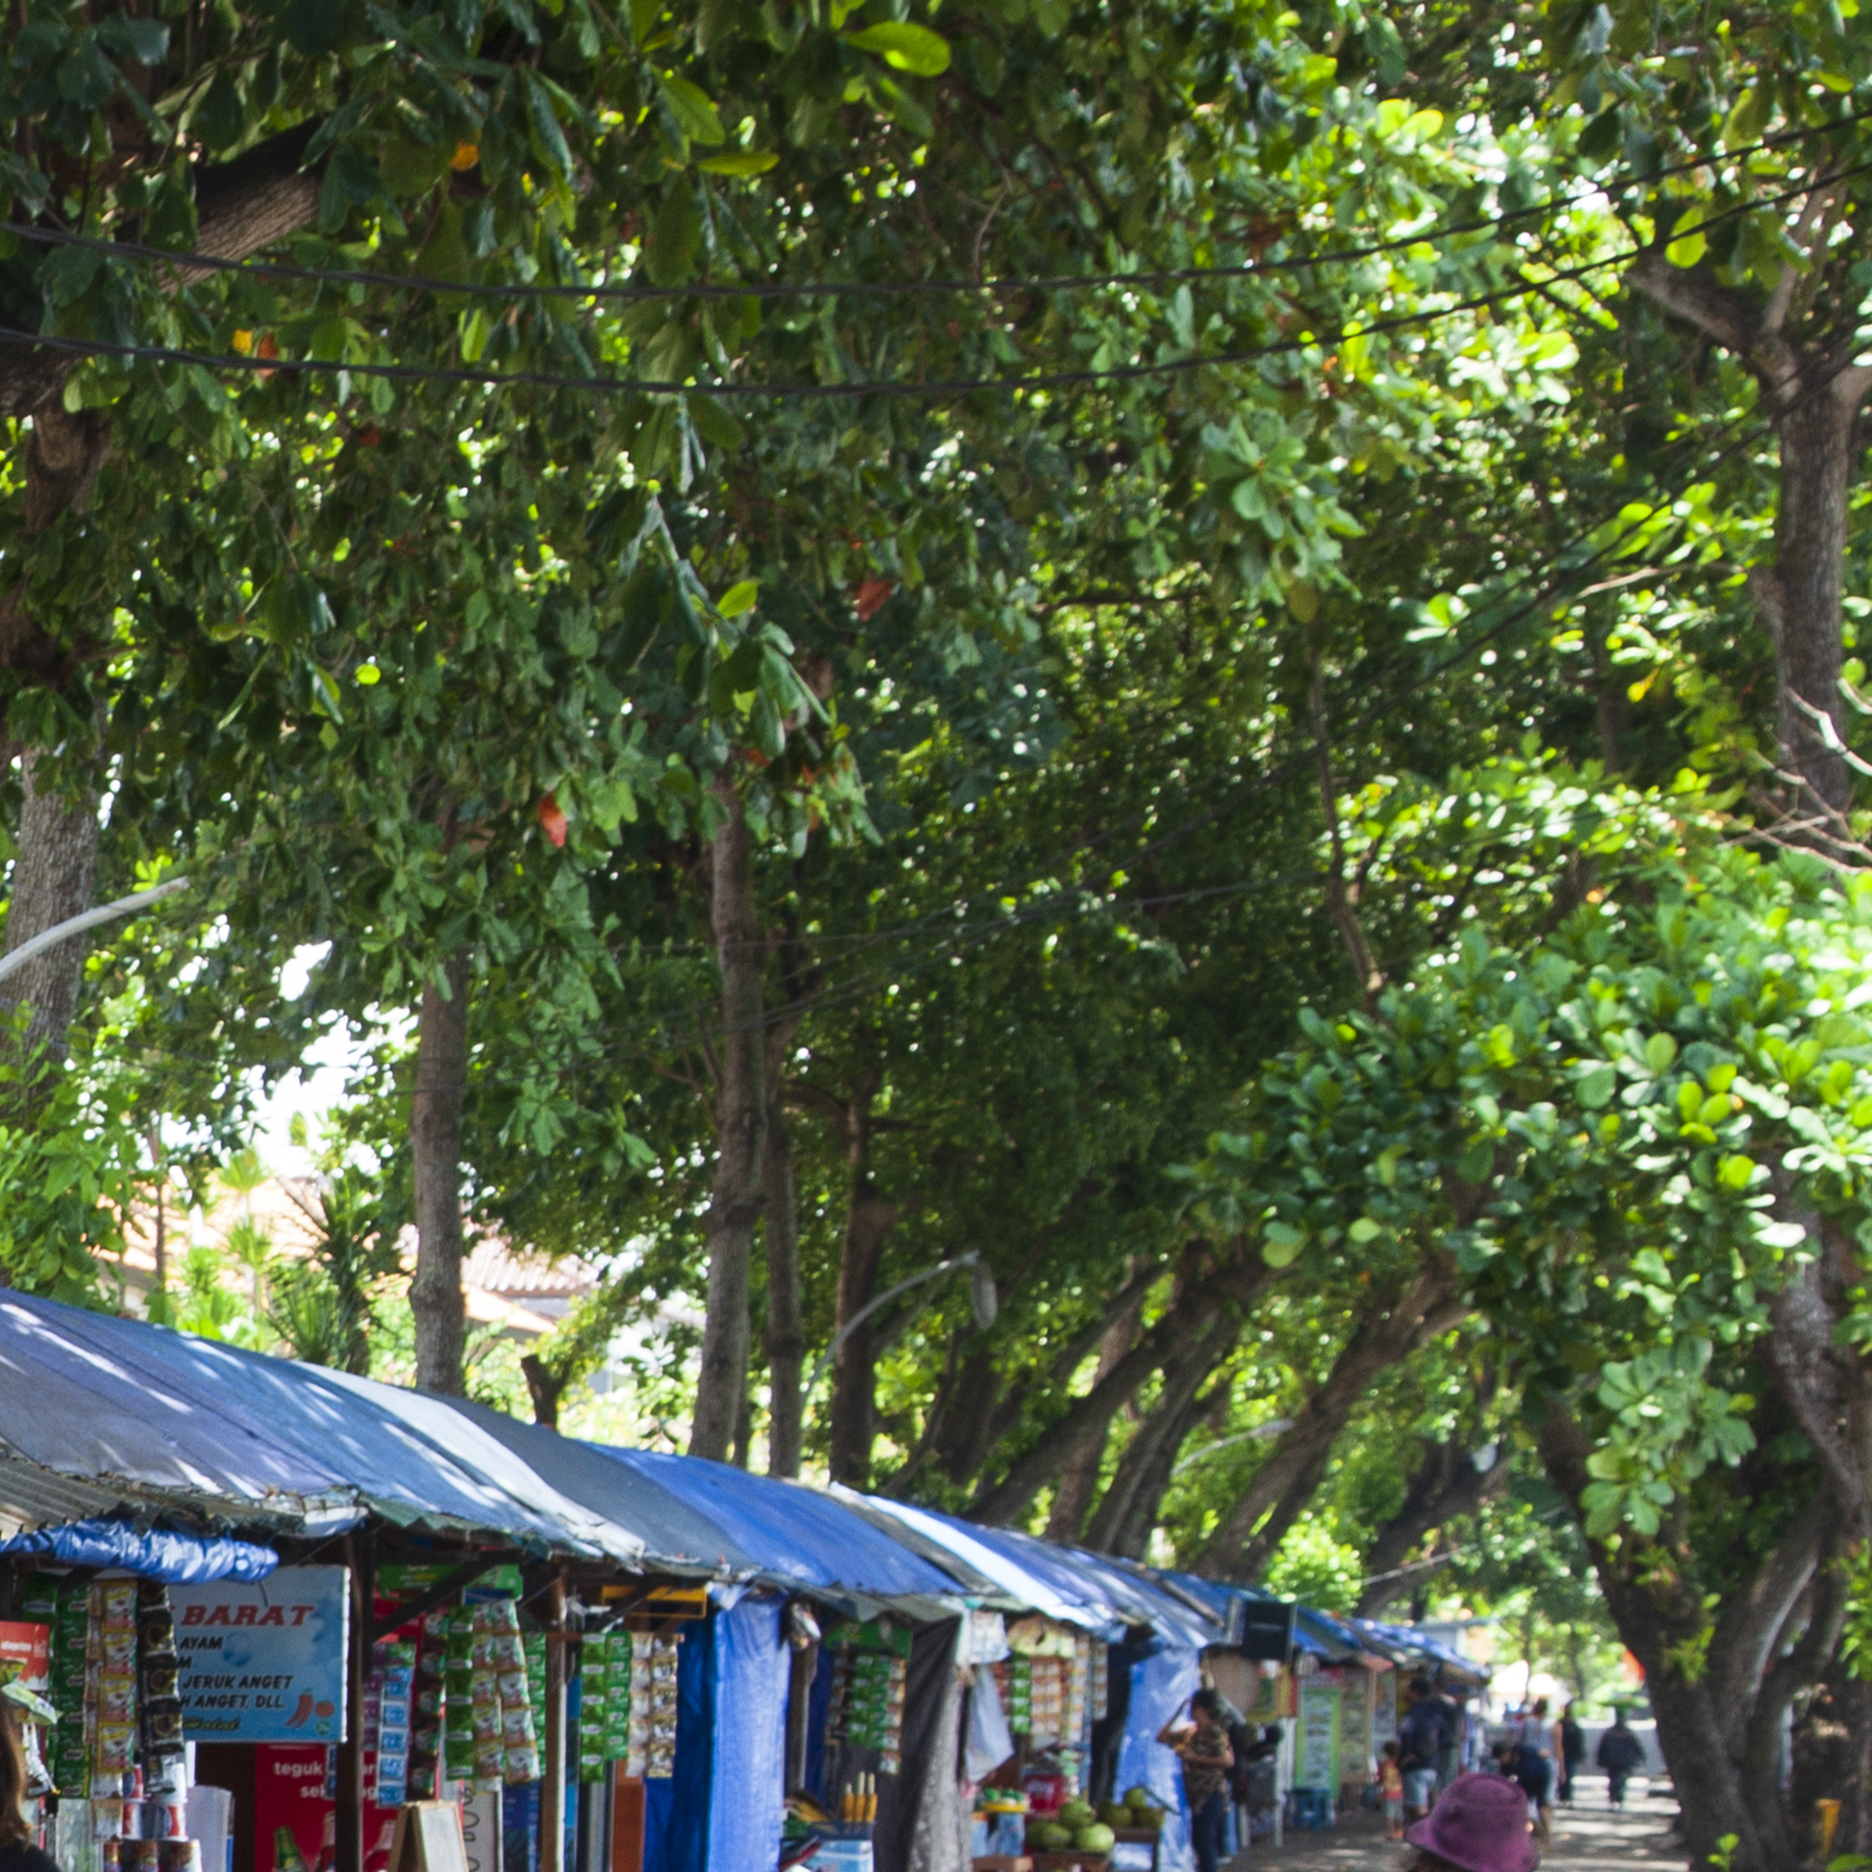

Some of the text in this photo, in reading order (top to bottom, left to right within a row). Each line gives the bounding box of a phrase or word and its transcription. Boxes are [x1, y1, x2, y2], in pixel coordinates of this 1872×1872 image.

[181, 1605, 316, 1627] BARAT
[180, 1637, 223, 1650] AYAM
[182, 1675, 294, 1689] JERUK ANGET
[273, 1760, 323, 1779] teguk
